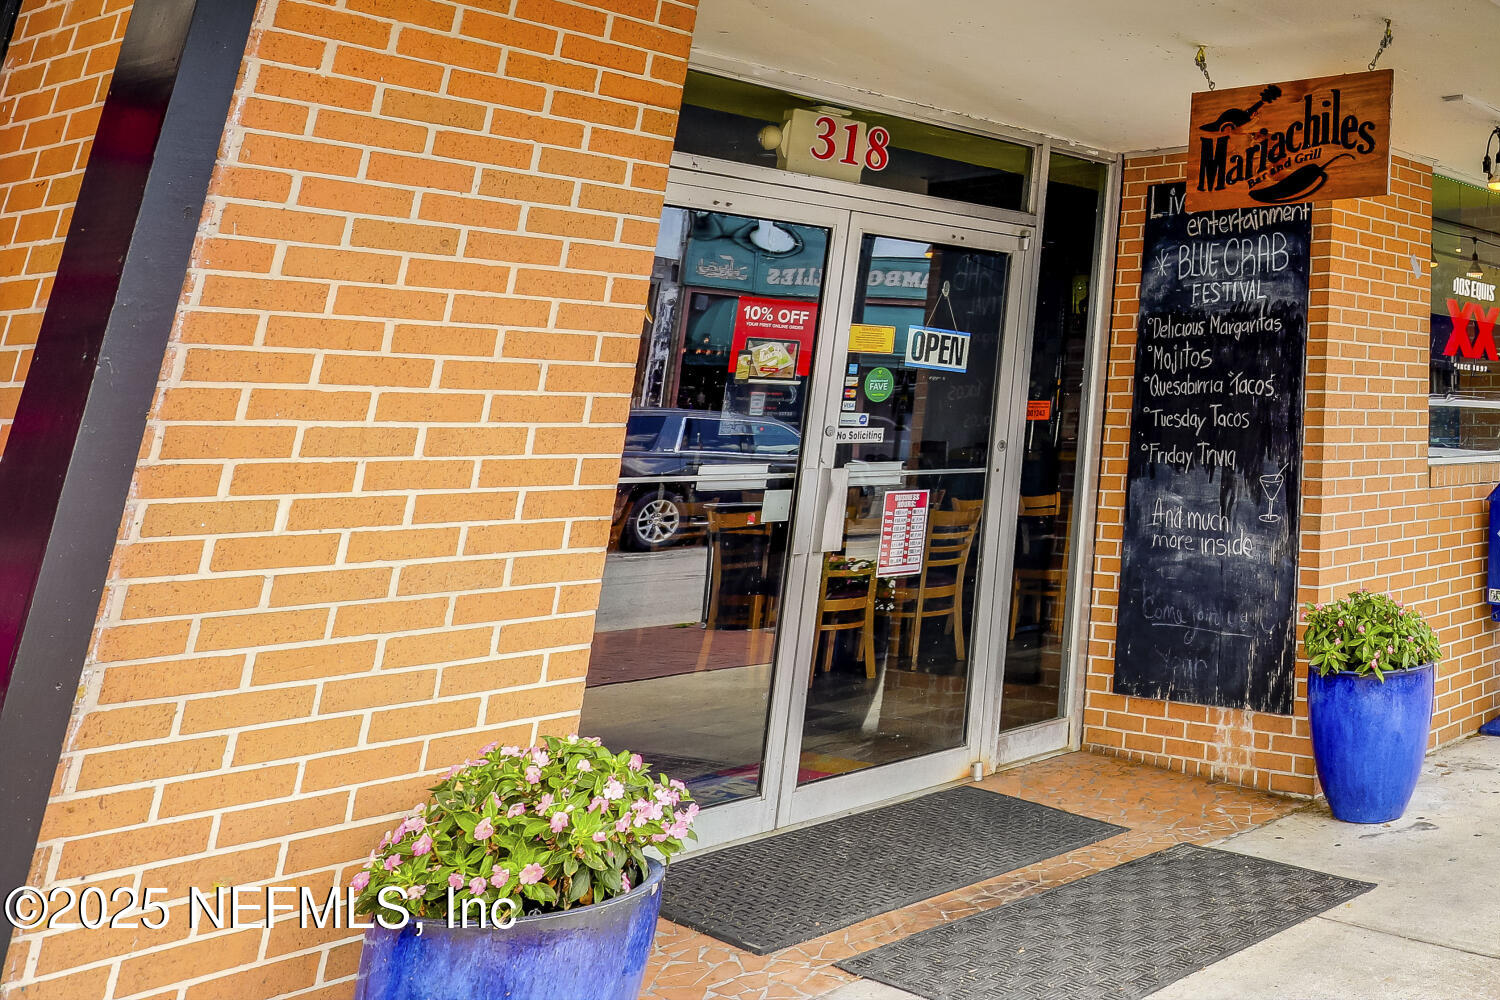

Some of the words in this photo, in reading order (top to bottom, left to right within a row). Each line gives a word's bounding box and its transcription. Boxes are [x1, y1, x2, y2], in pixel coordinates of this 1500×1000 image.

[810, 115, 891, 172] 318
[1197, 89, 1375, 192] Mariachiles
[1248, 175, 1267, 189] Bar
[1270, 158, 1291, 175] and
[1294, 148, 1322, 164] Grill
[1150, 186, 1188, 219] Liv
[1187, 202, 1310, 236] entertainment
[1178, 242, 1220, 280] BLUE
[1223, 232, 1289, 279] CRAB
[1192, 279, 1267, 304] FESTIVAL
[1471, 281, 1496, 301] EQUIS
[743, 305, 773, 321] 10%
[778, 309, 810, 324] OFF
[1152, 315, 1206, 339] Delicious
[1209, 308, 1282, 341] Margaritas
[1442, 298, 1500, 362] XX
[911, 331, 966, 367] OPEN
[1153, 341, 1213, 374] Mojitos
[869, 382, 888, 391] FAVE
[1150, 373, 1223, 396] Quesabirria
[836, 431, 846, 440] No
[849, 431, 882, 442] Soliciting
[1150, 408, 1206, 436] Tuesday
[1209, 404, 1250, 429] Tacos
[1149, 442, 1193, 473] Friday
[1197, 442, 1236, 470] Trivia
[1152, 498, 1183, 528] And
[1187, 506, 1229, 532] much
[1152, 533, 1195, 550] more
[1200, 528, 1253, 558] inside
